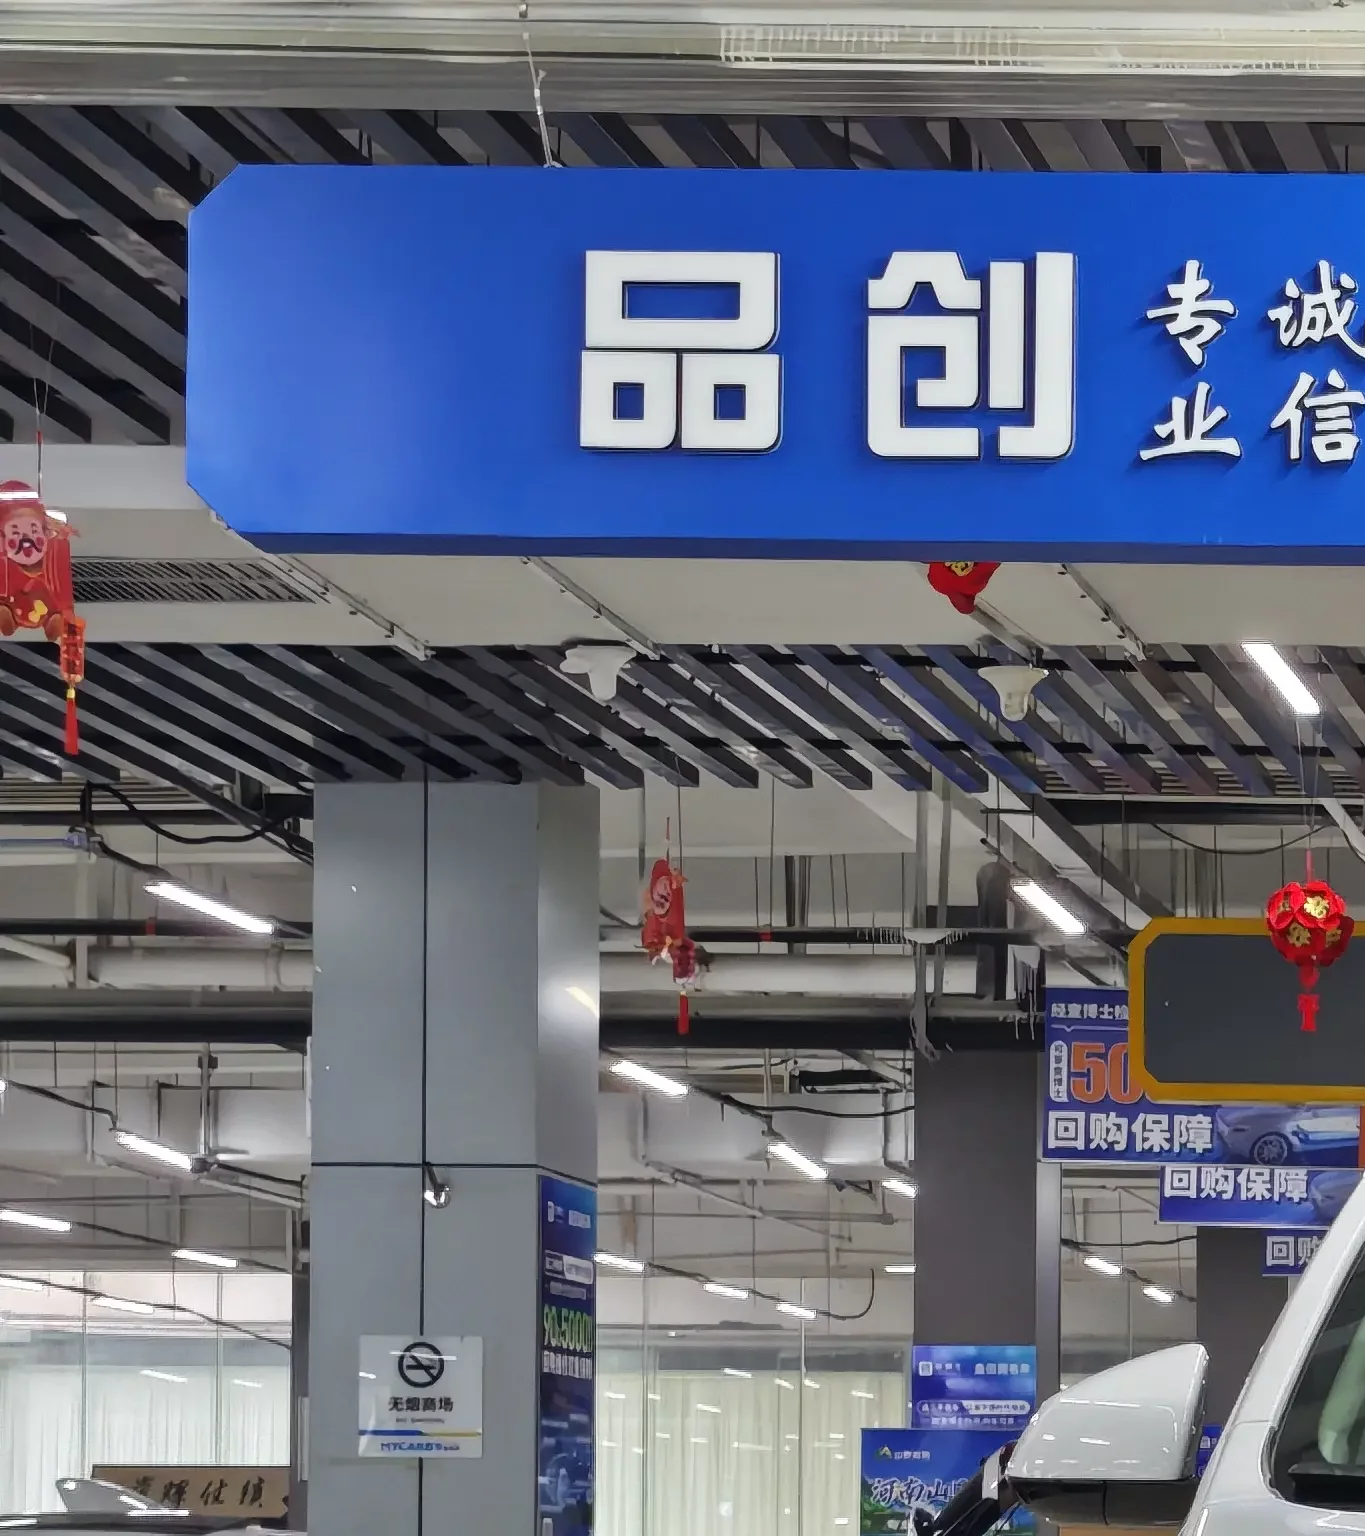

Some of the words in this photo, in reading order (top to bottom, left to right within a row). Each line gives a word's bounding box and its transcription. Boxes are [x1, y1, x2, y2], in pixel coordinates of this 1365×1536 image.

[580, 250, 1077, 460] 品创
[1047, 1110, 1213, 1154] 回购保障
[1163, 1165, 1309, 1203] 回购保障
